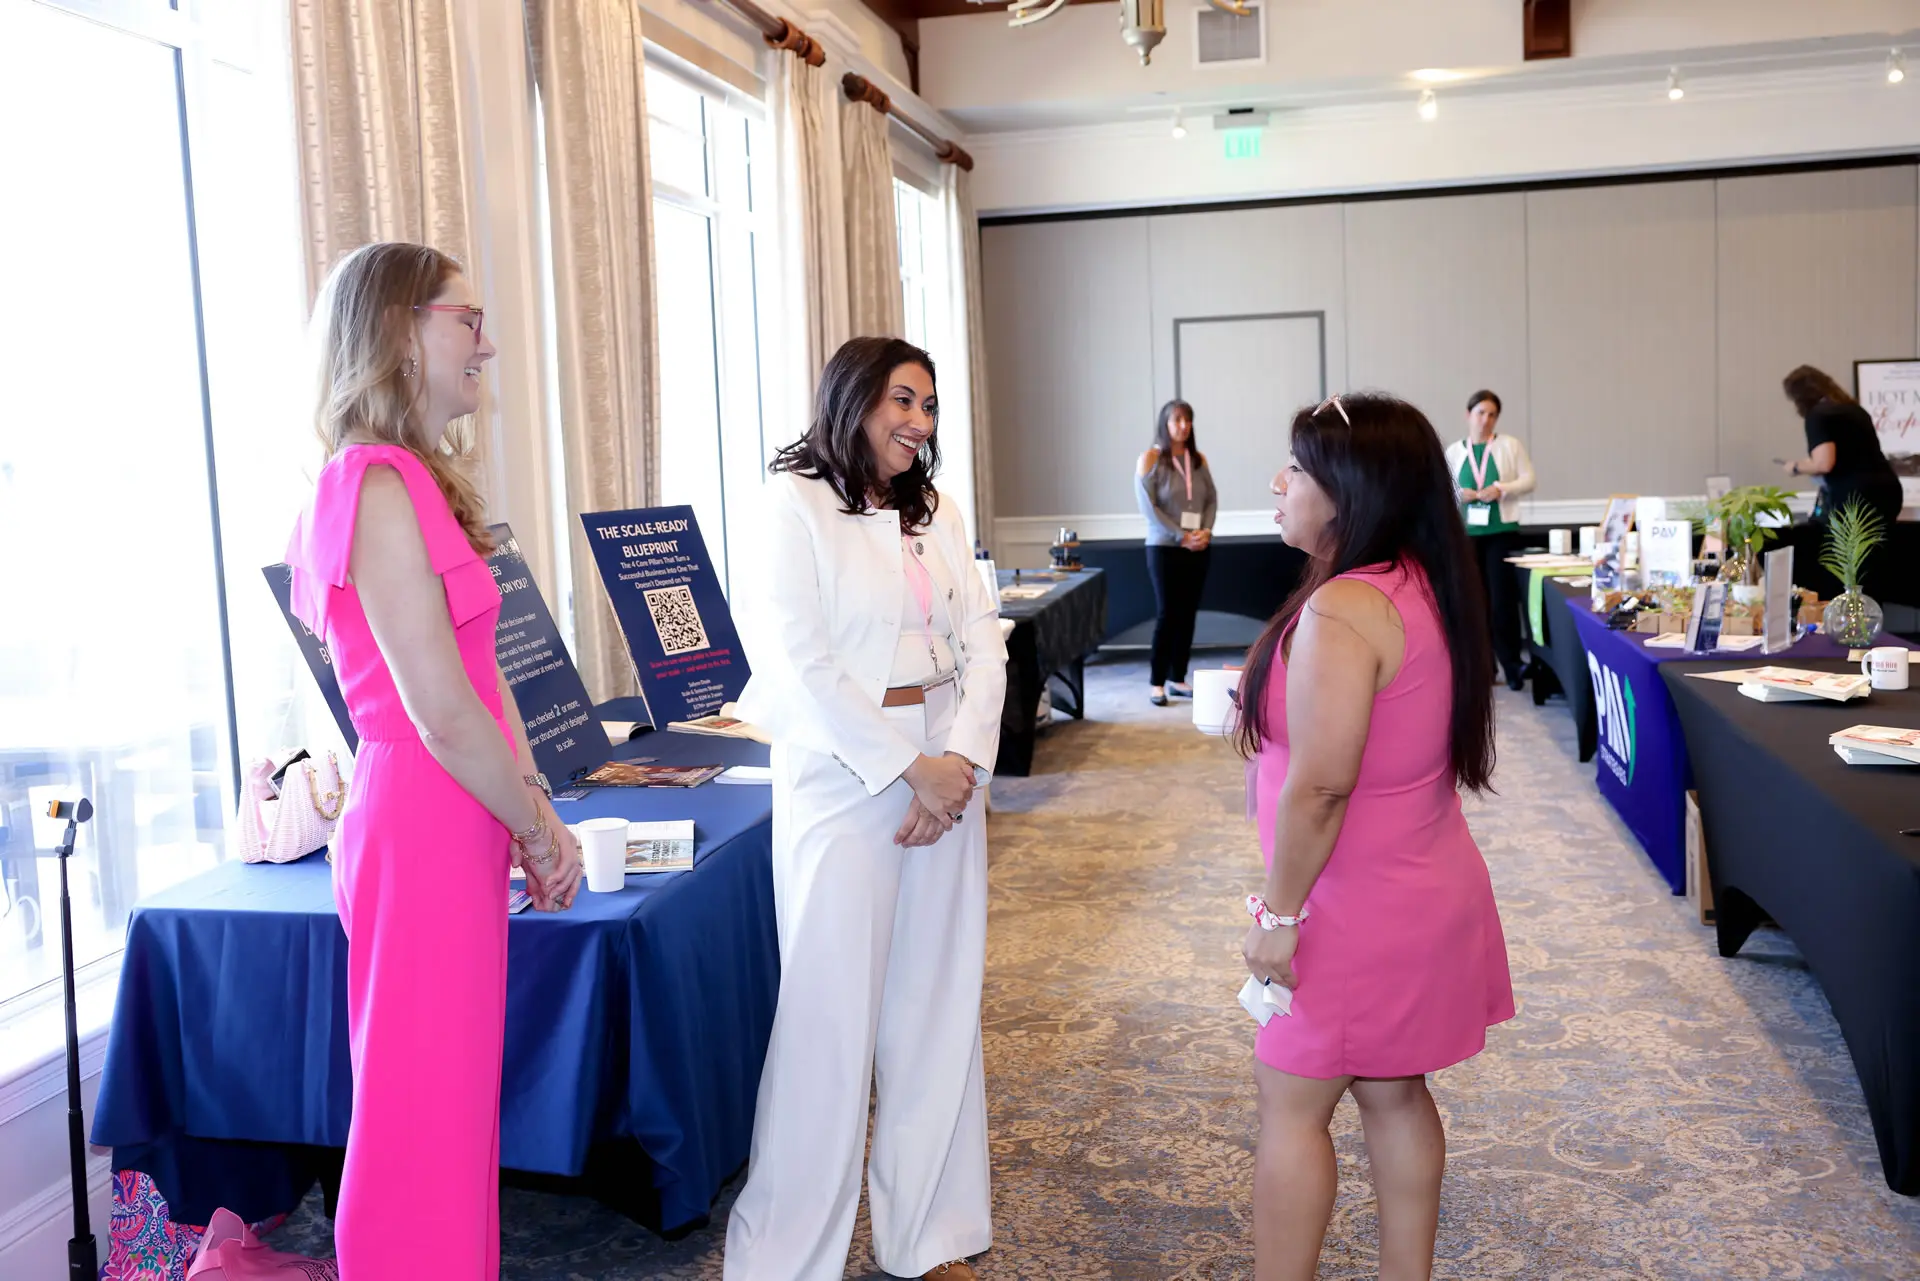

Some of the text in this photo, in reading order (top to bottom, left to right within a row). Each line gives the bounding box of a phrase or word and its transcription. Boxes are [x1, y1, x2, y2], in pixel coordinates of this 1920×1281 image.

[596, 519, 689, 540] THE SCALE-READY
[622, 540, 679, 558] BLUEPRINT
[620, 562, 631, 570] The
[636, 560, 648, 568] Core
[648, 558, 664, 566] Pillars
[662, 556, 675, 564] That
[674, 555, 686, 563] Turn
[618, 571, 645, 581] Successful
[644, 568, 667, 577] Business
[676, 565, 688, 573] One
[501, 581, 514, 594] ON
[512, 577, 530, 591] YOU?
[634, 580, 656, 590] Doesn't
[654, 577, 674, 588] Depend
[508, 612, 536, 627] decision-maker
[530, 636, 547, 648] approval
[526, 721, 537, 732] you
[536, 708, 556, 725] checked
[554, 704, 562, 716] 2
[567, 700, 580, 711] more,
[528, 711, 589, 750] your structure isn't designed
[556, 737, 576, 752] to scale.
